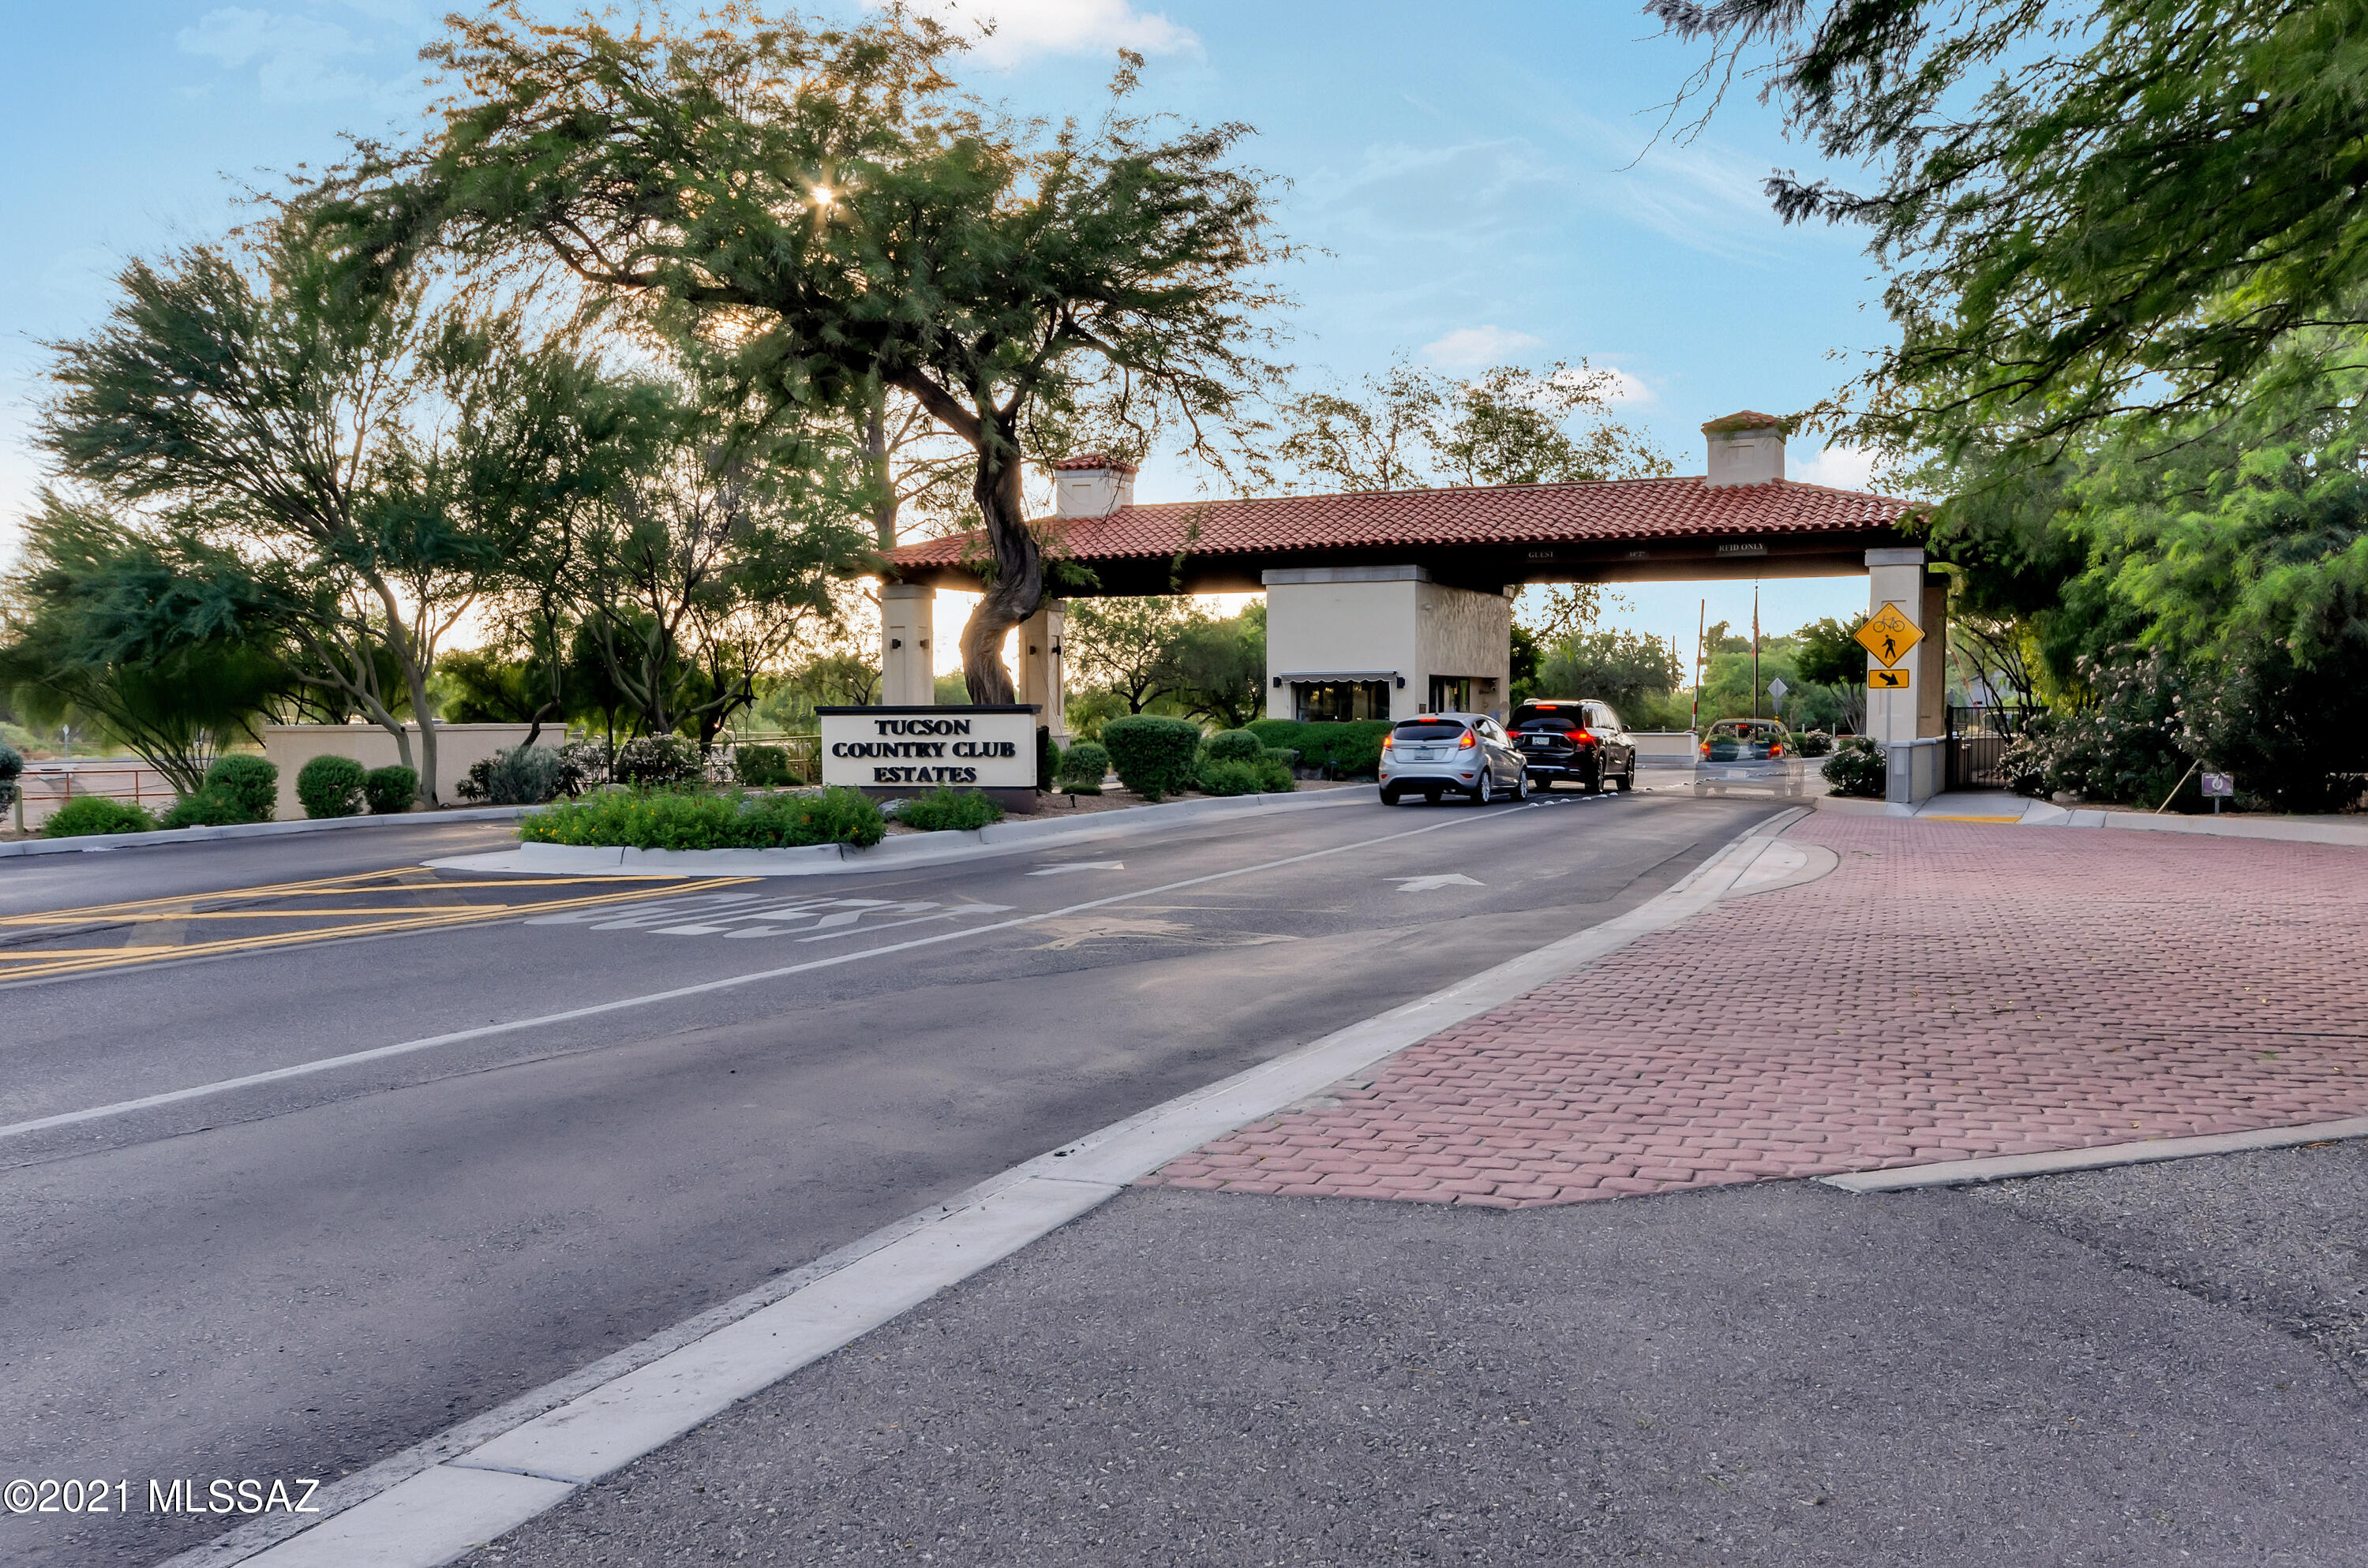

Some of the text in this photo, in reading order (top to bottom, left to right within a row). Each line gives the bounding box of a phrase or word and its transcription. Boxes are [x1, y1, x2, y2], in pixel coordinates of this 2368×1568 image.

[874, 719, 972, 735] TUCSON
[832, 741, 1016, 758] COUNTRY CLUB
[873, 766, 977, 783] ESTATES
